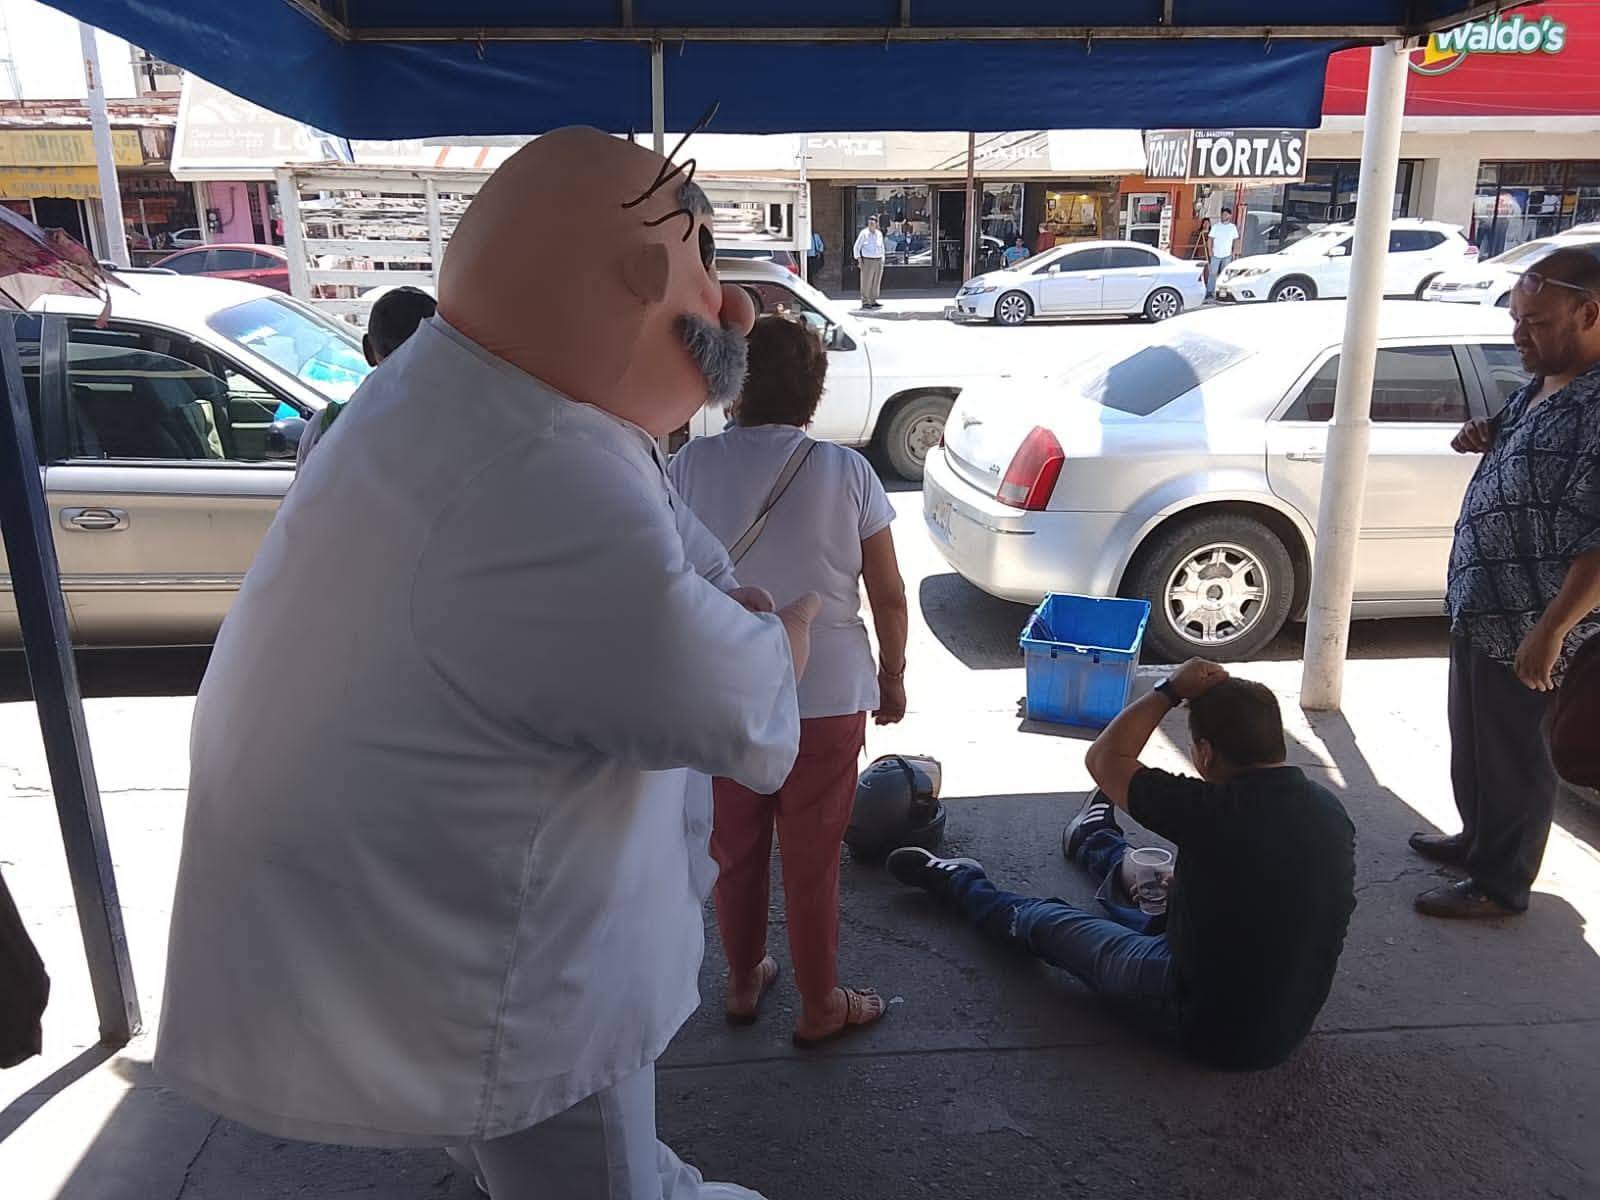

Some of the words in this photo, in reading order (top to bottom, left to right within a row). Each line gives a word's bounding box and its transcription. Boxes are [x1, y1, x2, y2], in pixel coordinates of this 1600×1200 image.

[1437, 15, 1565, 52] Waldo's
[1148, 139, 1187, 177] TORTAS
[1196, 137, 1302, 177] TORTAS
